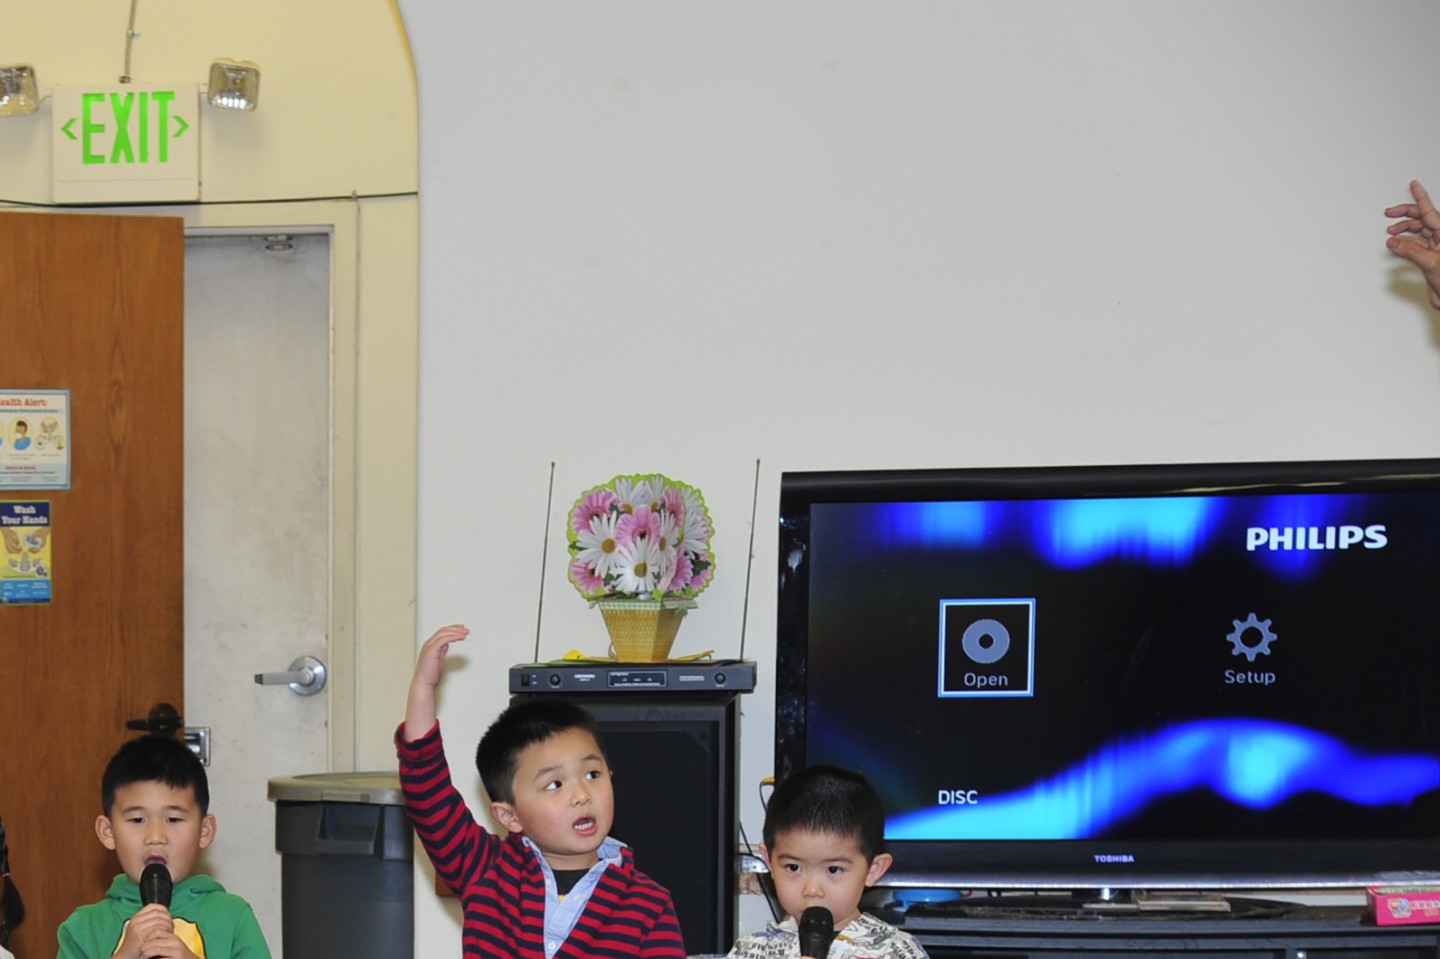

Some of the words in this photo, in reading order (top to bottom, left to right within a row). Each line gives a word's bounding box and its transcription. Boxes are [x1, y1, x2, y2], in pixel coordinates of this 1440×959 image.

[82, 91, 175, 164] EXIT
[13, 505, 36, 514] Wash
[1, 516, 21, 525] Your
[22, 516, 48, 524] Hands
[1246, 525, 1388, 551] PHILIPS
[963, 672, 1008, 688] Open
[1224, 669, 1276, 686] Setup
[938, 789, 979, 805] DISC
[1094, 854, 1135, 863] TOSHIBA
